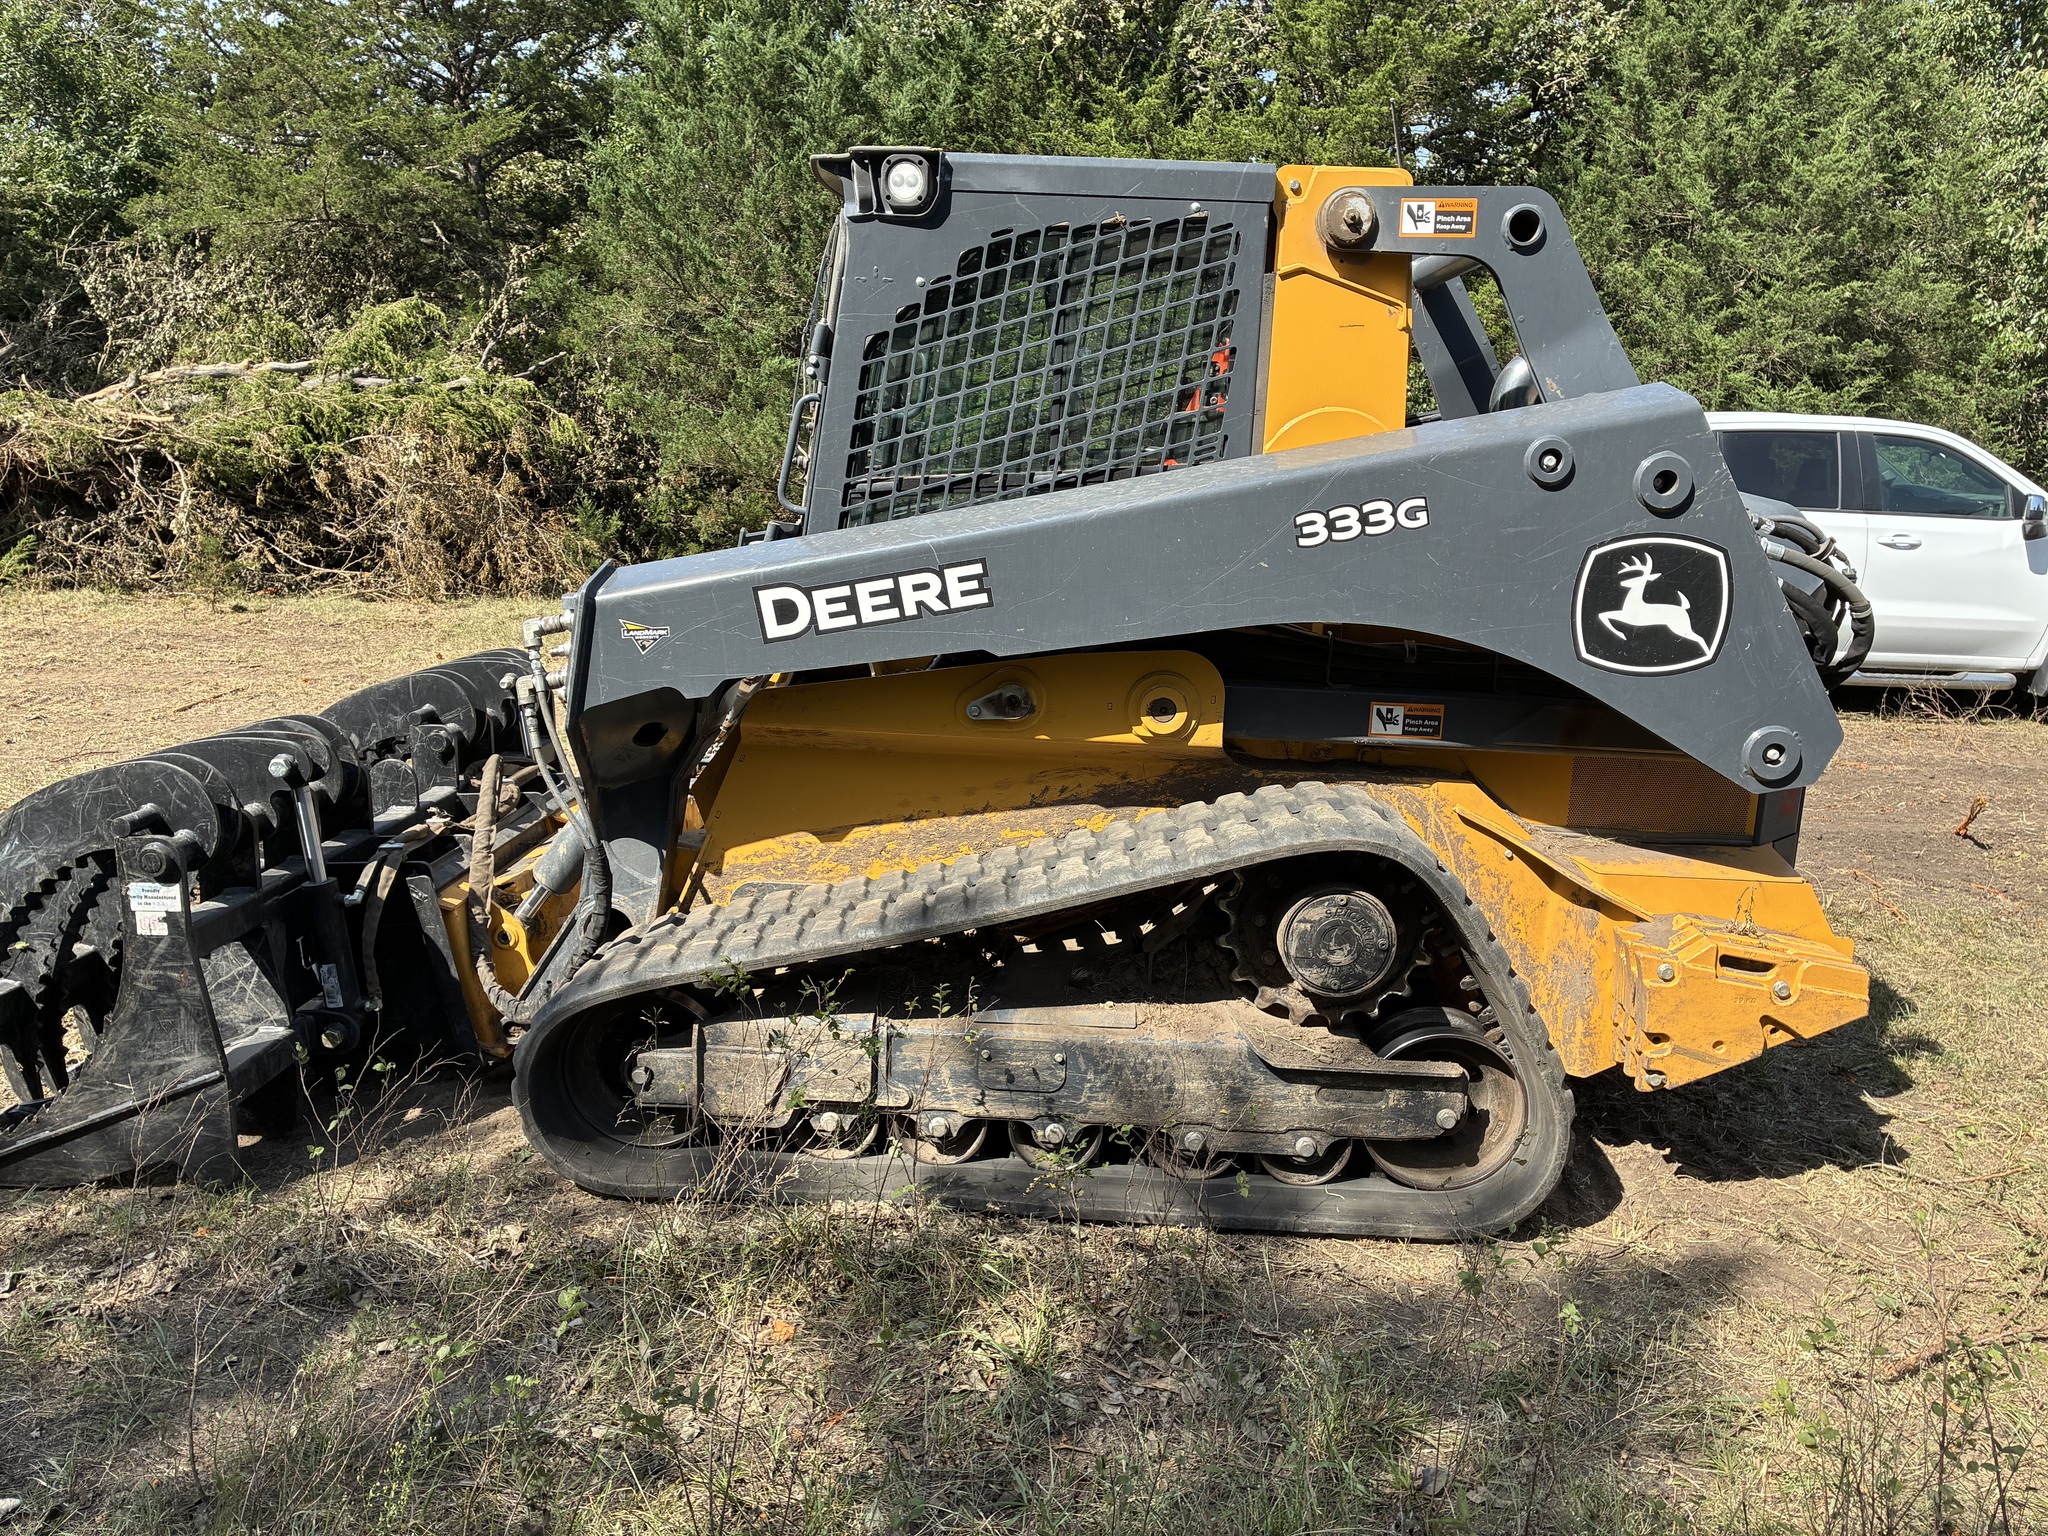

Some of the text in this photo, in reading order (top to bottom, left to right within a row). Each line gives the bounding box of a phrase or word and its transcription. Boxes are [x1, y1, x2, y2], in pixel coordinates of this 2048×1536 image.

[1451, 223, 1466, 231] Away
[1295, 497, 1428, 547] 333G
[757, 562, 989, 639] DEERE
